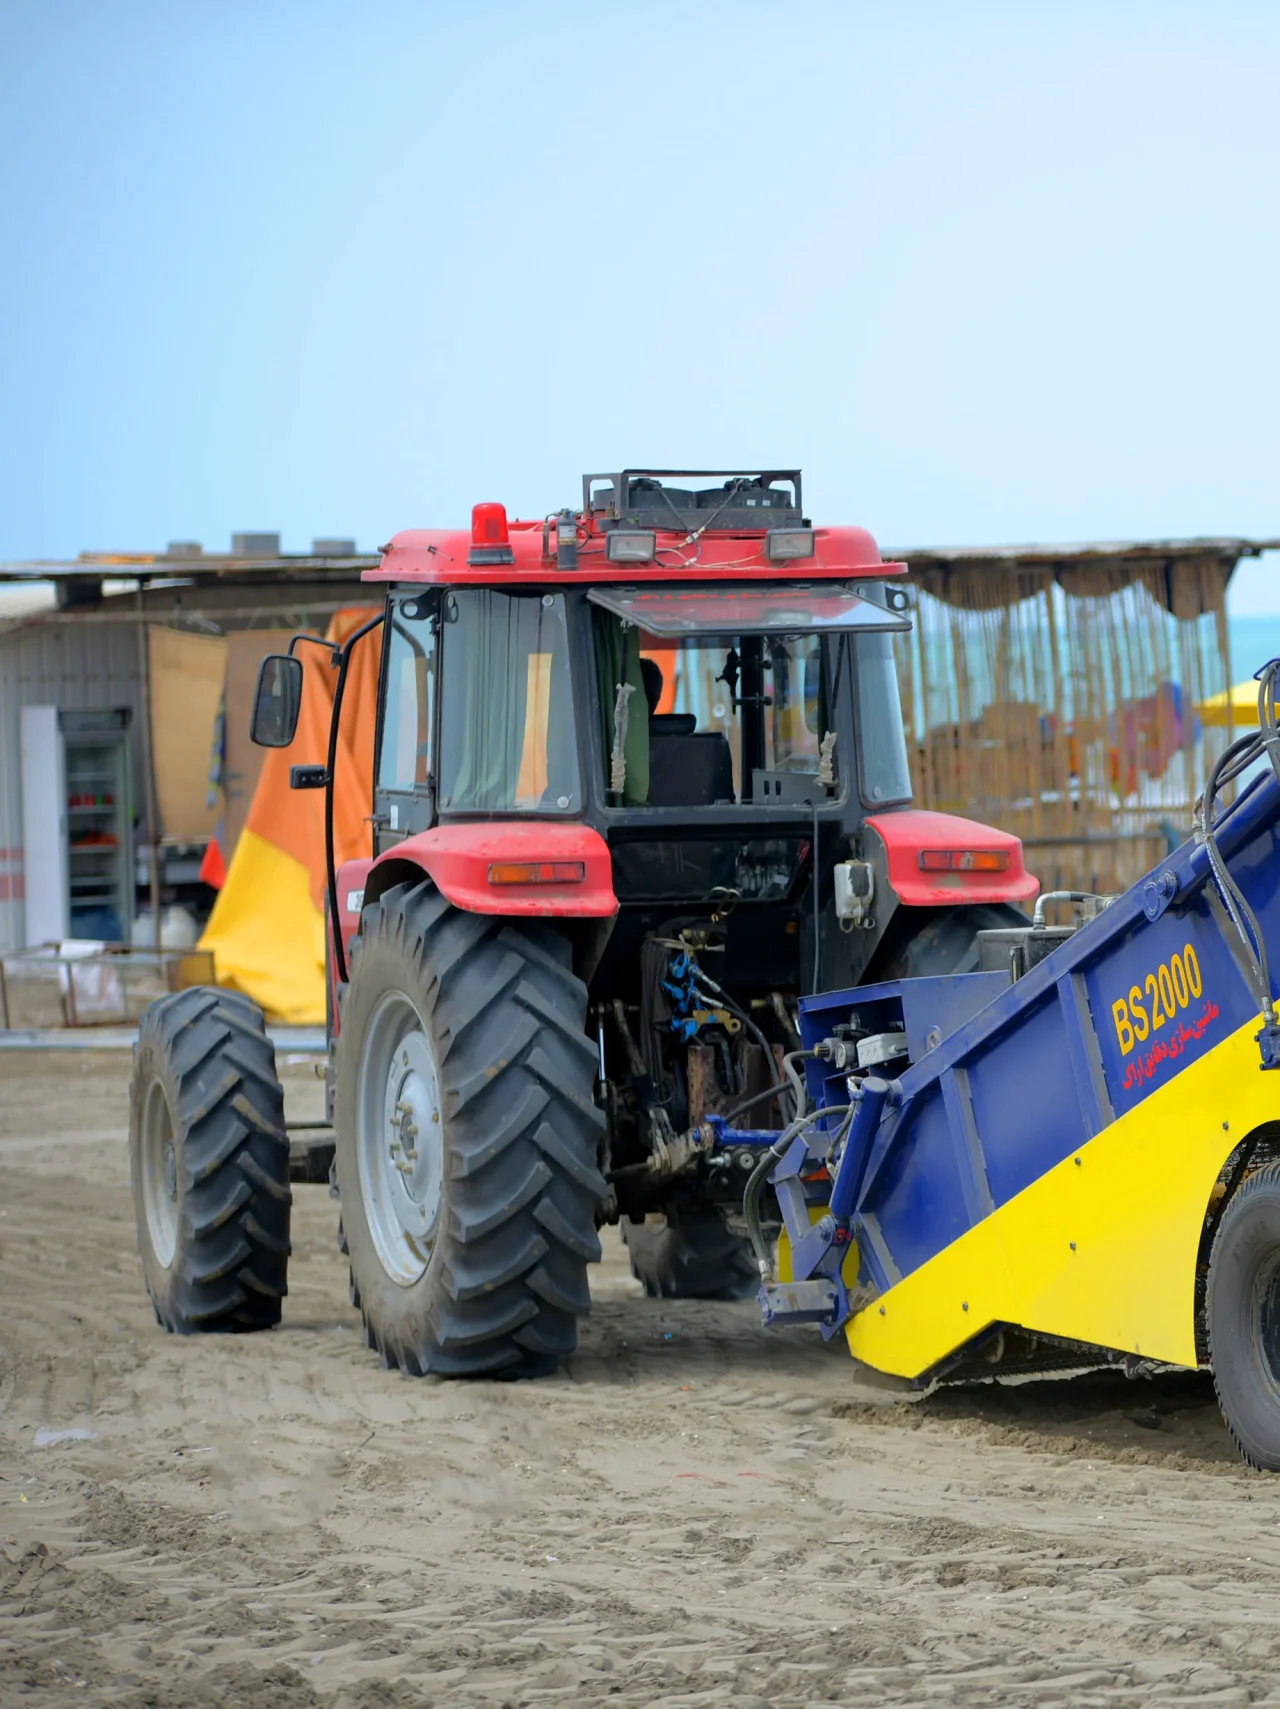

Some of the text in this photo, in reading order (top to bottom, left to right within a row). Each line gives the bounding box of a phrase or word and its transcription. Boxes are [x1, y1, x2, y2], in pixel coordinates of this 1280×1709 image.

[1111, 943, 1203, 1056] BS2000
[1168, 1022, 1193, 1059] سازی
[1122, 1056, 1146, 1090] اراک
